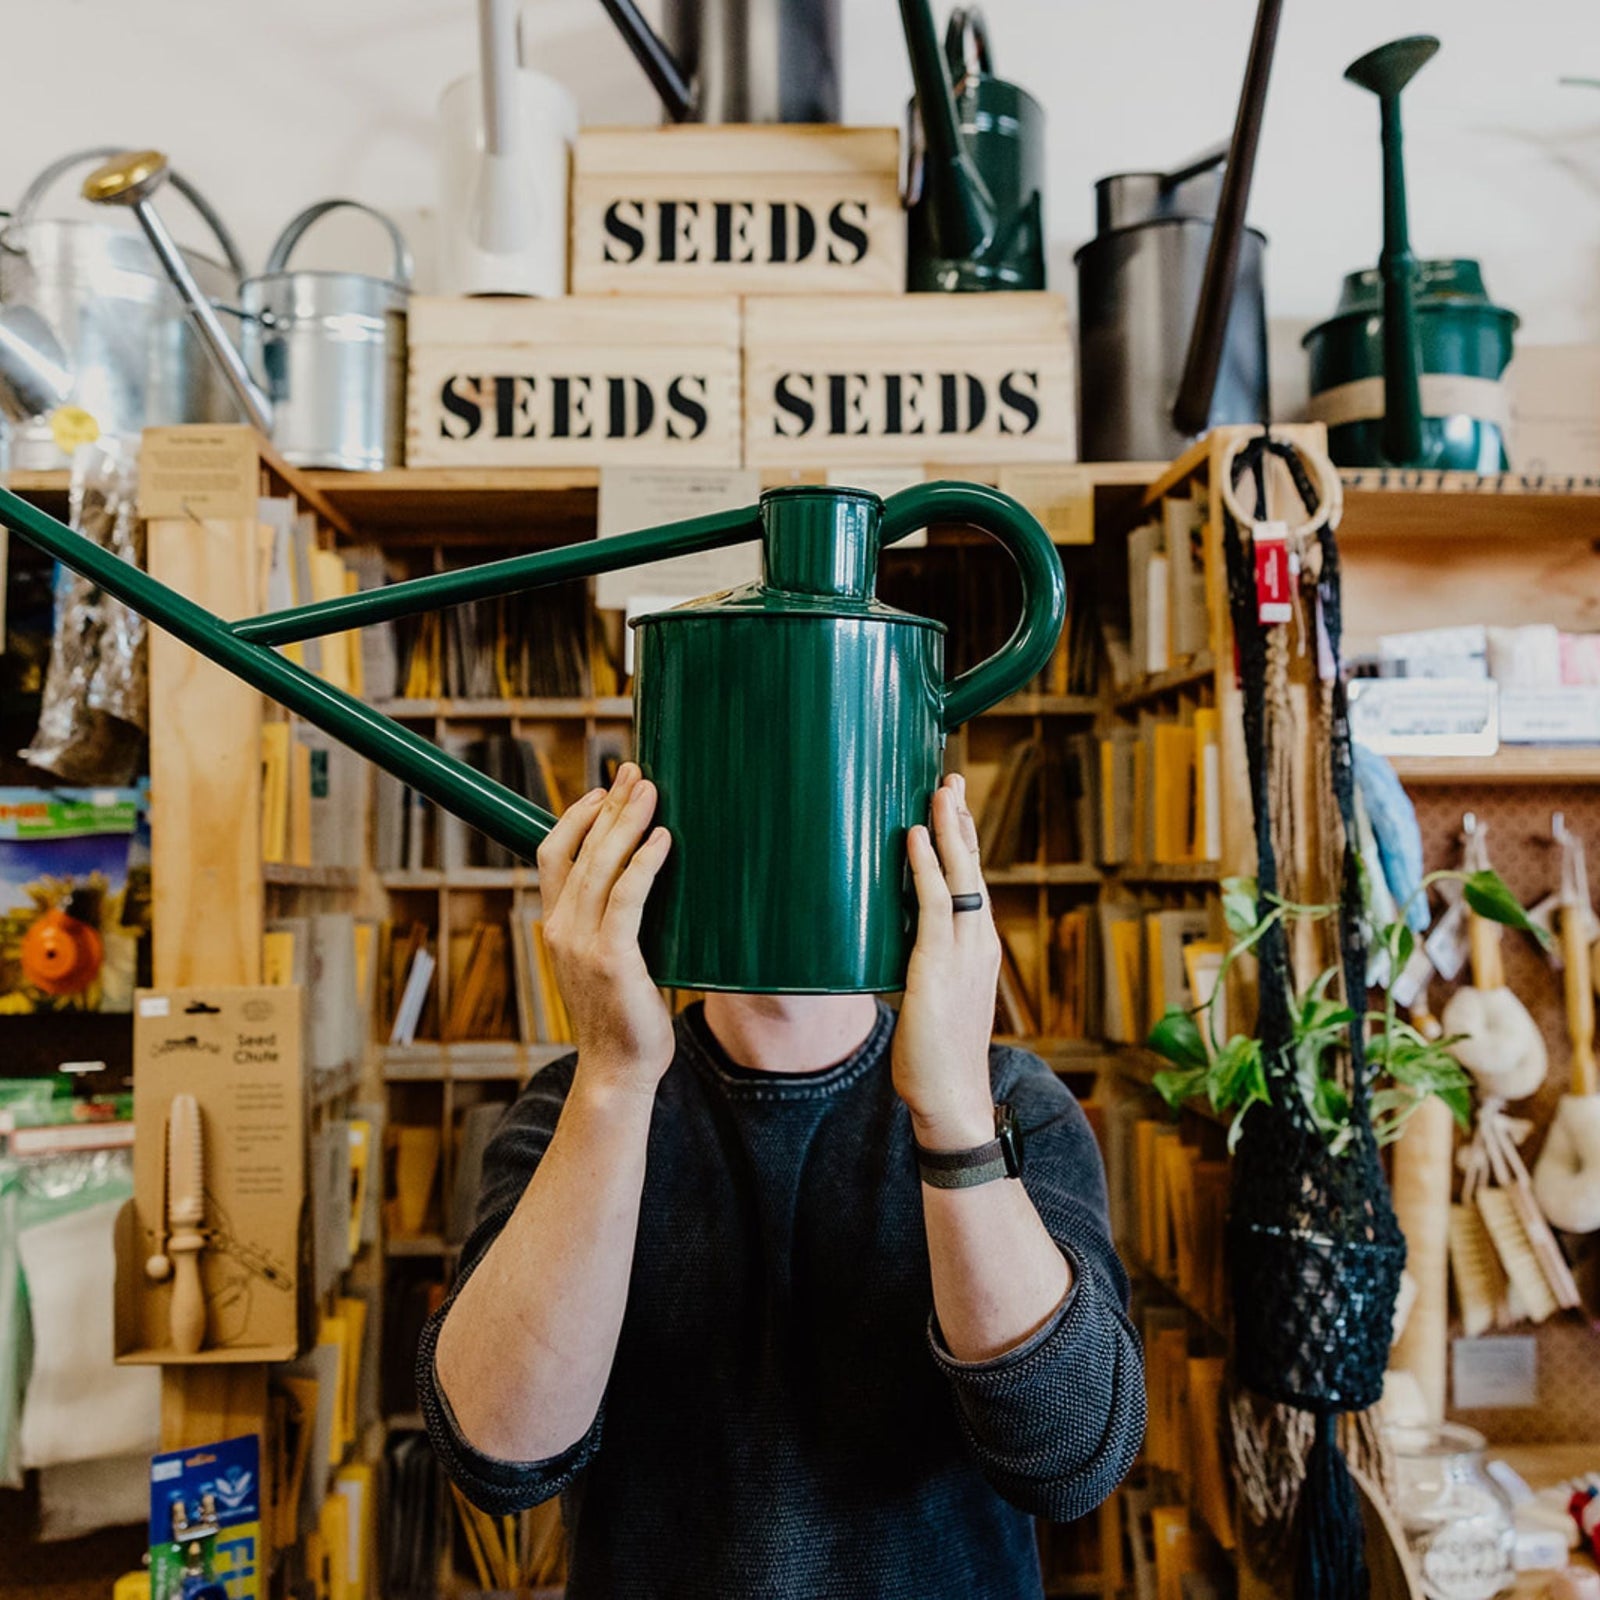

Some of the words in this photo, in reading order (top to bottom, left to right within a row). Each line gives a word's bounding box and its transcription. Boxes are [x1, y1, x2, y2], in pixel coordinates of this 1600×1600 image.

[603, 200, 870, 265] SEEDS
[440, 375, 708, 440] SEEDS
[773, 372, 1040, 437] SEEDS
[233, 1050, 280, 1064] Chute
[237, 1033, 277, 1047] Seed
